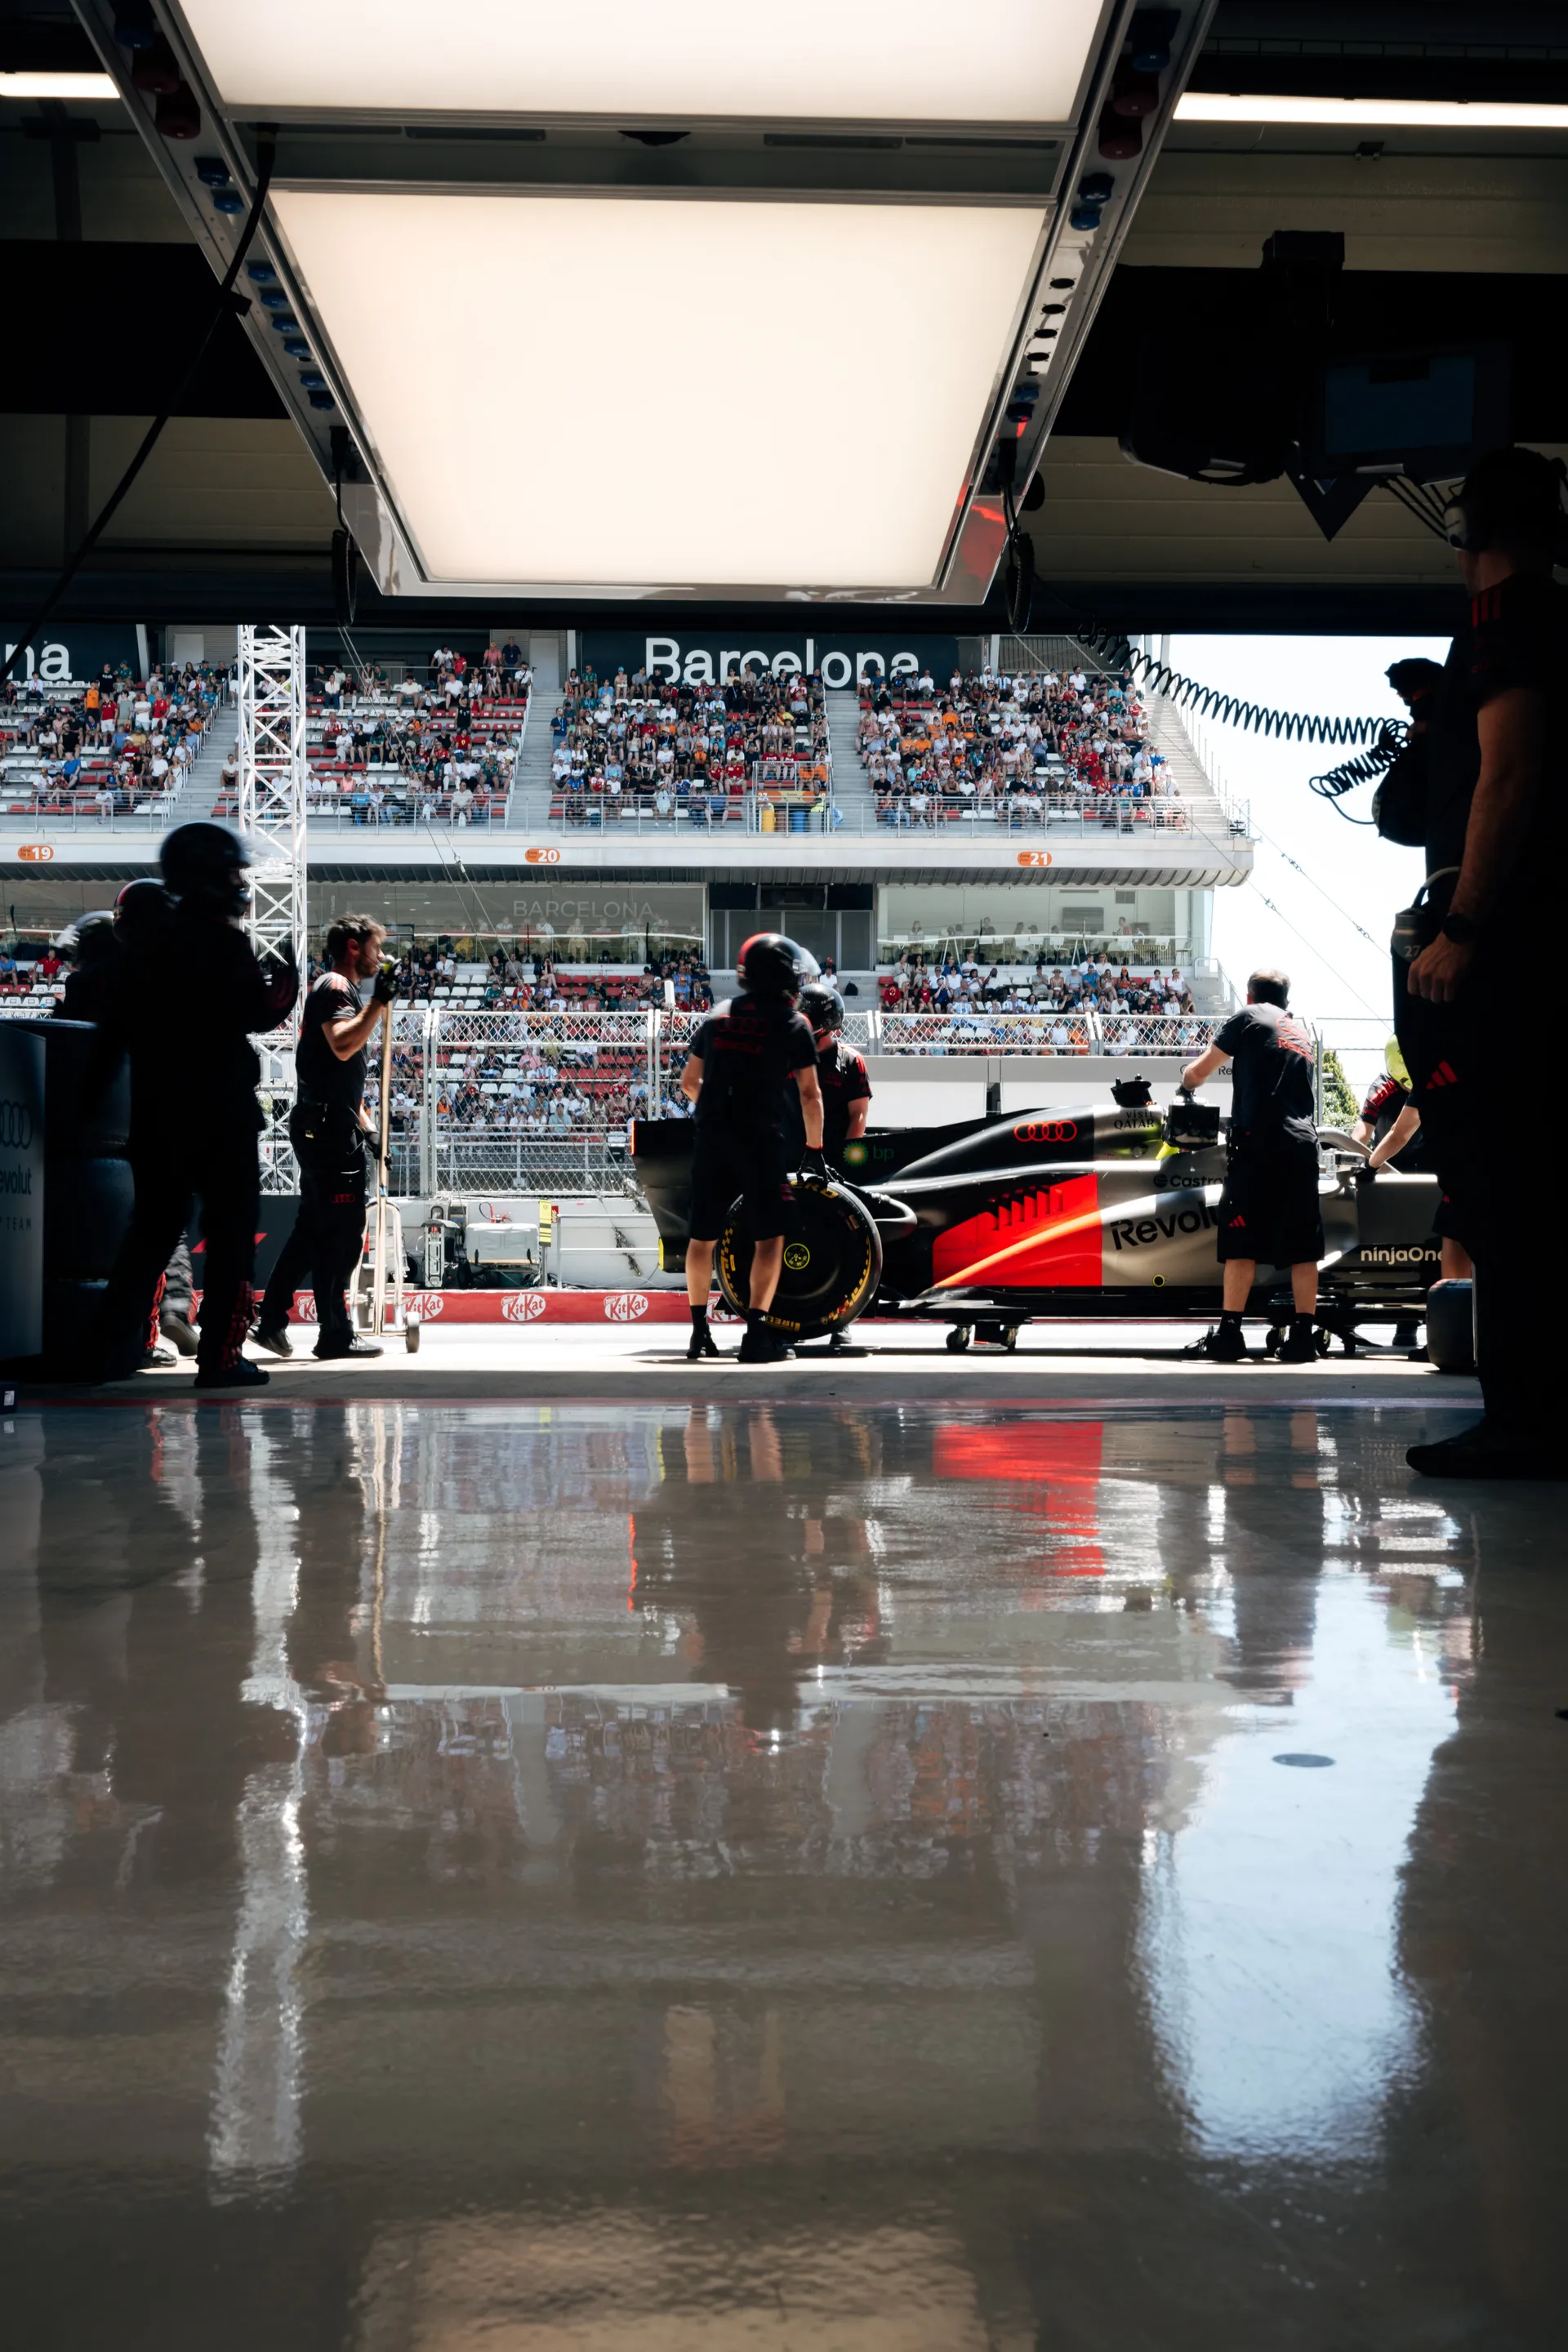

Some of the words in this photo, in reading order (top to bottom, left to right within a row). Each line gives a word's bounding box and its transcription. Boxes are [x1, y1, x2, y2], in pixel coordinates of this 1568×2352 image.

[645, 638, 919, 688] Barcelona
[32, 847, 51, 859] 19
[538, 849, 558, 862] 20
[1030, 853, 1048, 865] 21
[513, 900, 655, 918] BARCELONA
[1405, 946, 1421, 957] 27
[1114, 1119, 1155, 1130] QATAR
[873, 1145, 894, 1163] bp
[7, 1217, 31, 1231] TEAM
[1110, 1201, 1218, 1250] Revolu
[507, 1295, 543, 1321] KitKat
[610, 1294, 646, 1320] KitKat
